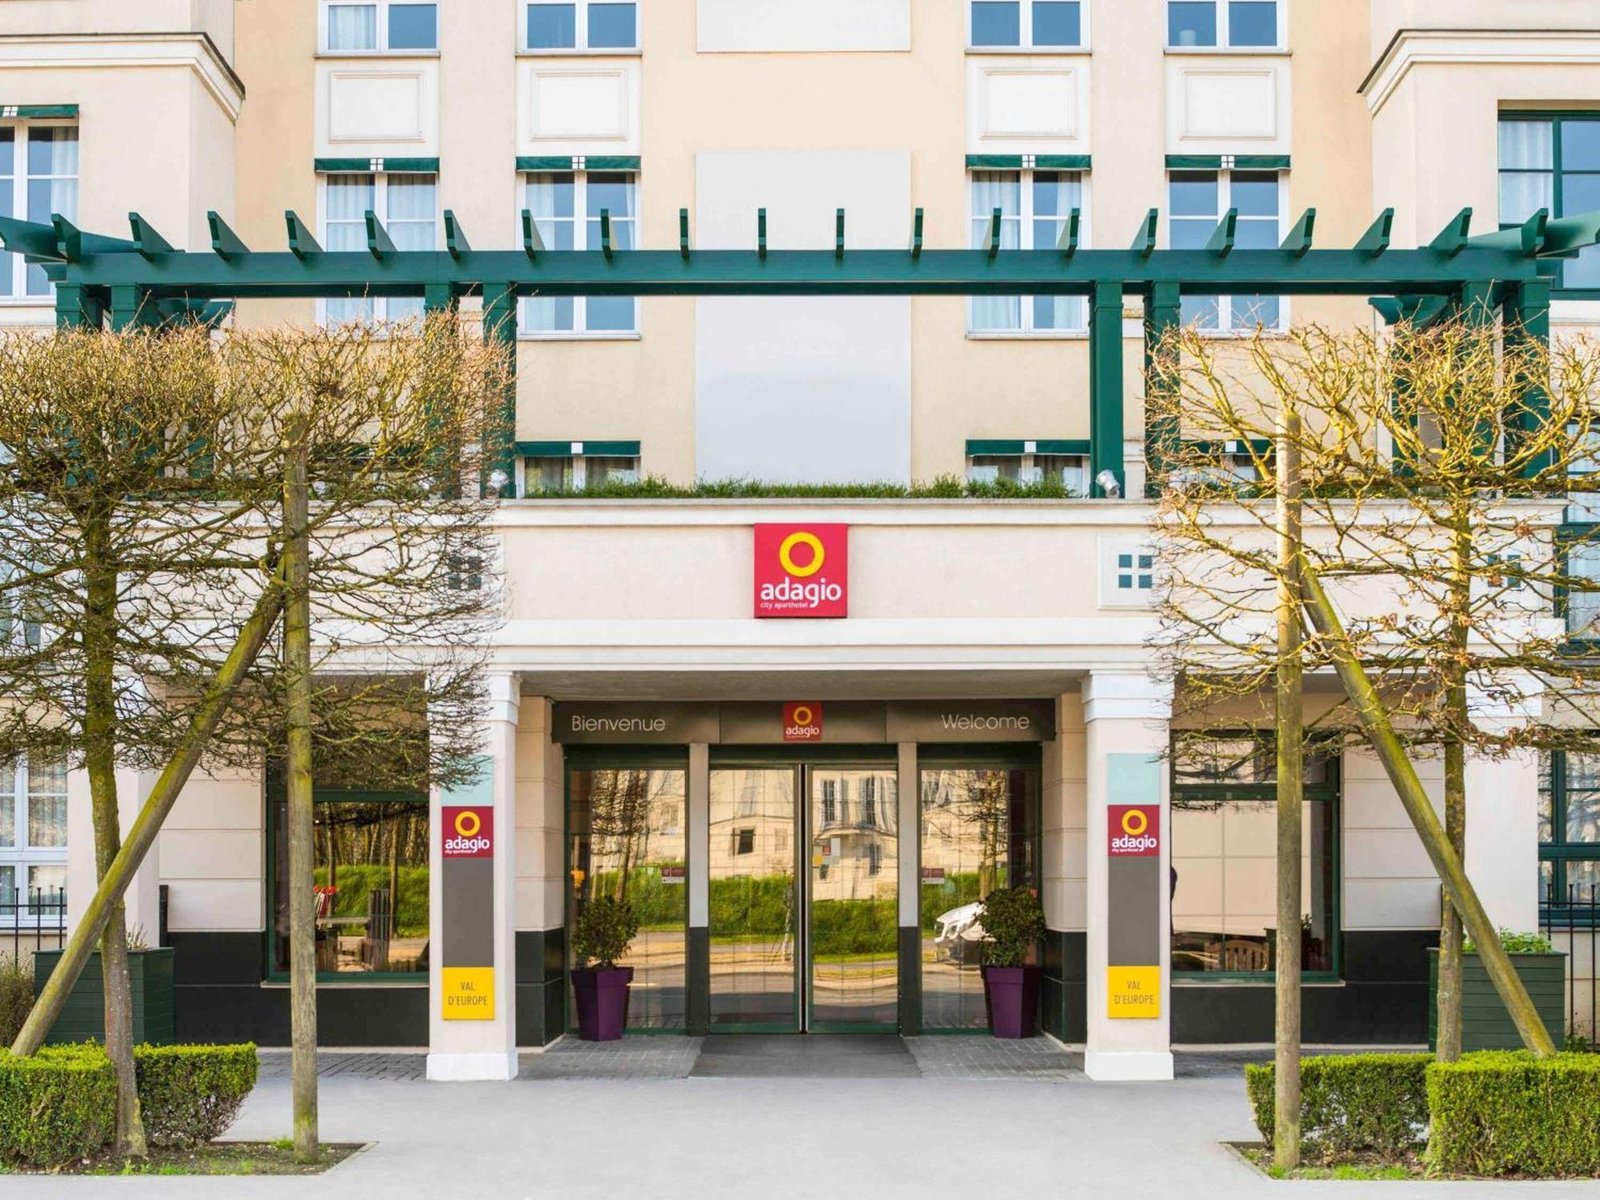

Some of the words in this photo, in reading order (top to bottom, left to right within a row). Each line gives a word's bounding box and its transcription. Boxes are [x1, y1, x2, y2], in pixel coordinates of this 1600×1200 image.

[760, 576, 842, 608] adagio
[760, 602, 773, 610] city
[774, 602, 809, 610] aparthotel
[571, 715, 666, 731] Bienvenue
[941, 714, 1030, 729] Welcome
[785, 725, 820, 738] adagio
[444, 835, 490, 853] adagio
[1111, 834, 1158, 852] adagio
[460, 981, 476, 991] VAL
[1126, 980, 1142, 990] VAL
[448, 995, 488, 1006] D'EUROPE
[1114, 994, 1154, 1005] D'EUROPE
